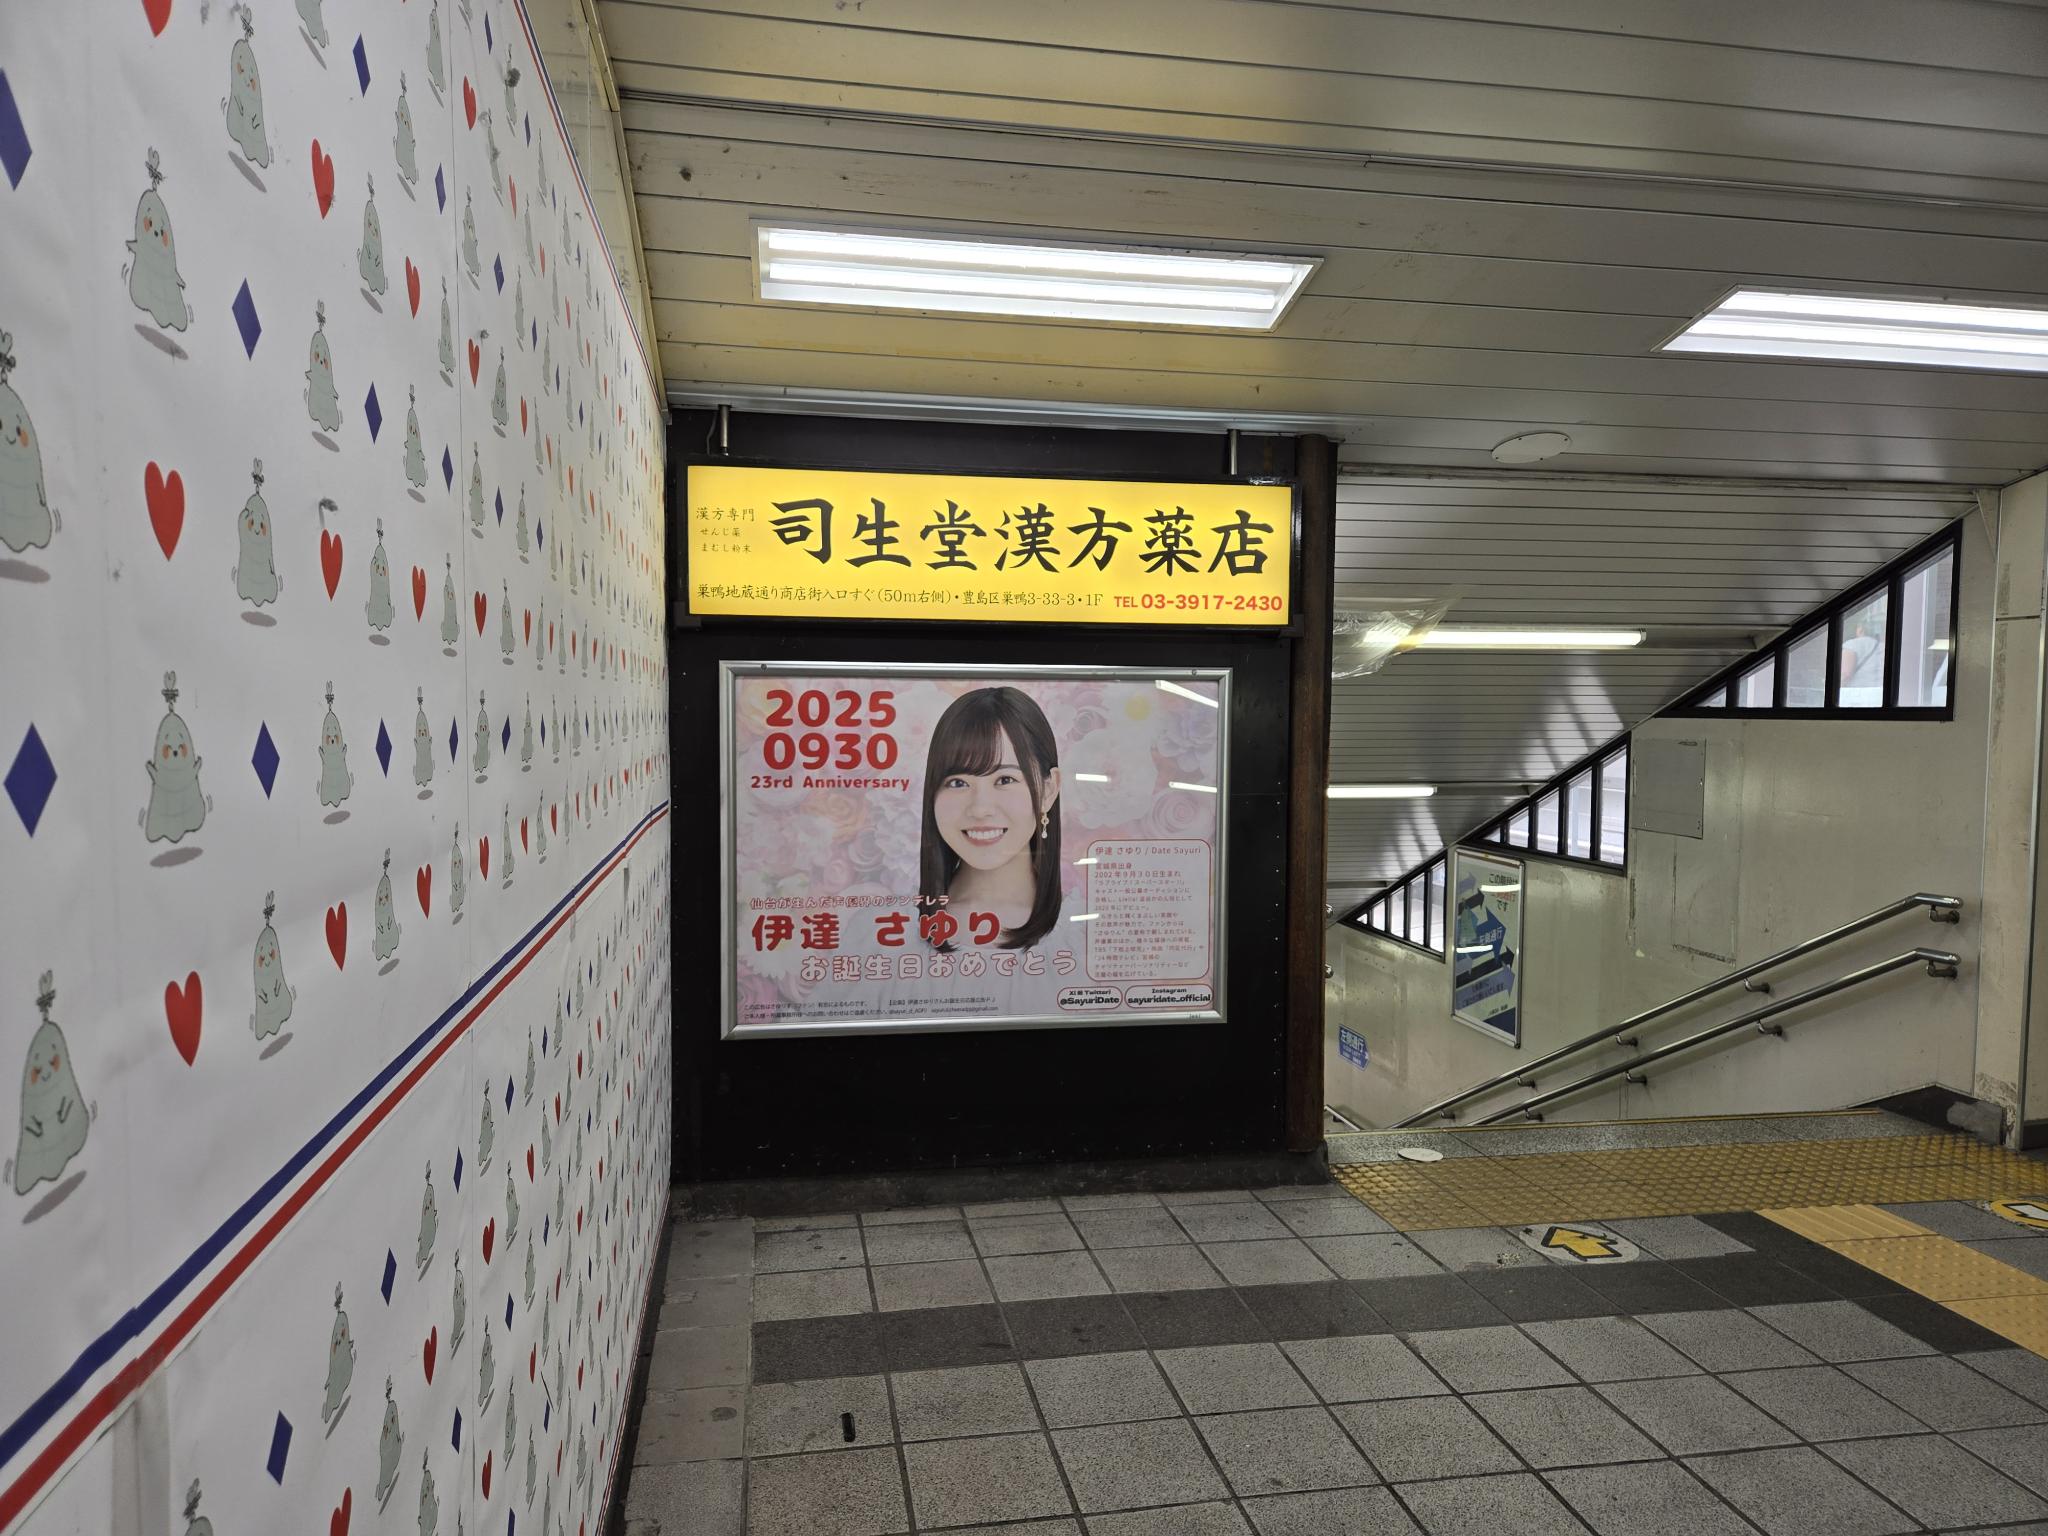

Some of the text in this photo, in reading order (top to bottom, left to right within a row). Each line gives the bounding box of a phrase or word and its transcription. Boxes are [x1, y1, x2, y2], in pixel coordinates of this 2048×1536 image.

[696, 507, 755, 522] 漢方専門
[699, 527, 742, 537] せんじ薬
[768, 498, 1275, 578] 司生堂漢方薬店
[700, 543, 753, 553] まむし粉末
[1114, 596, 1139, 608] TEL
[1141, 594, 1283, 611] 03-3917-2430
[766, 689, 897, 728] 2025
[763, 732, 898, 770] 0930
[751, 775, 910, 791] 23rd Anniversary
[1117, 847, 1142, 855] さゆり
[1174, 847, 1201, 855] Sayuri
[752, 910, 1000, 951] 伊達 さゆり
[800, 951, 1077, 982] お誕生日おめでとう
[1060, 997, 1120, 1006] @SayuriDate
[1128, 994, 1211, 1005] sayuridate_official
